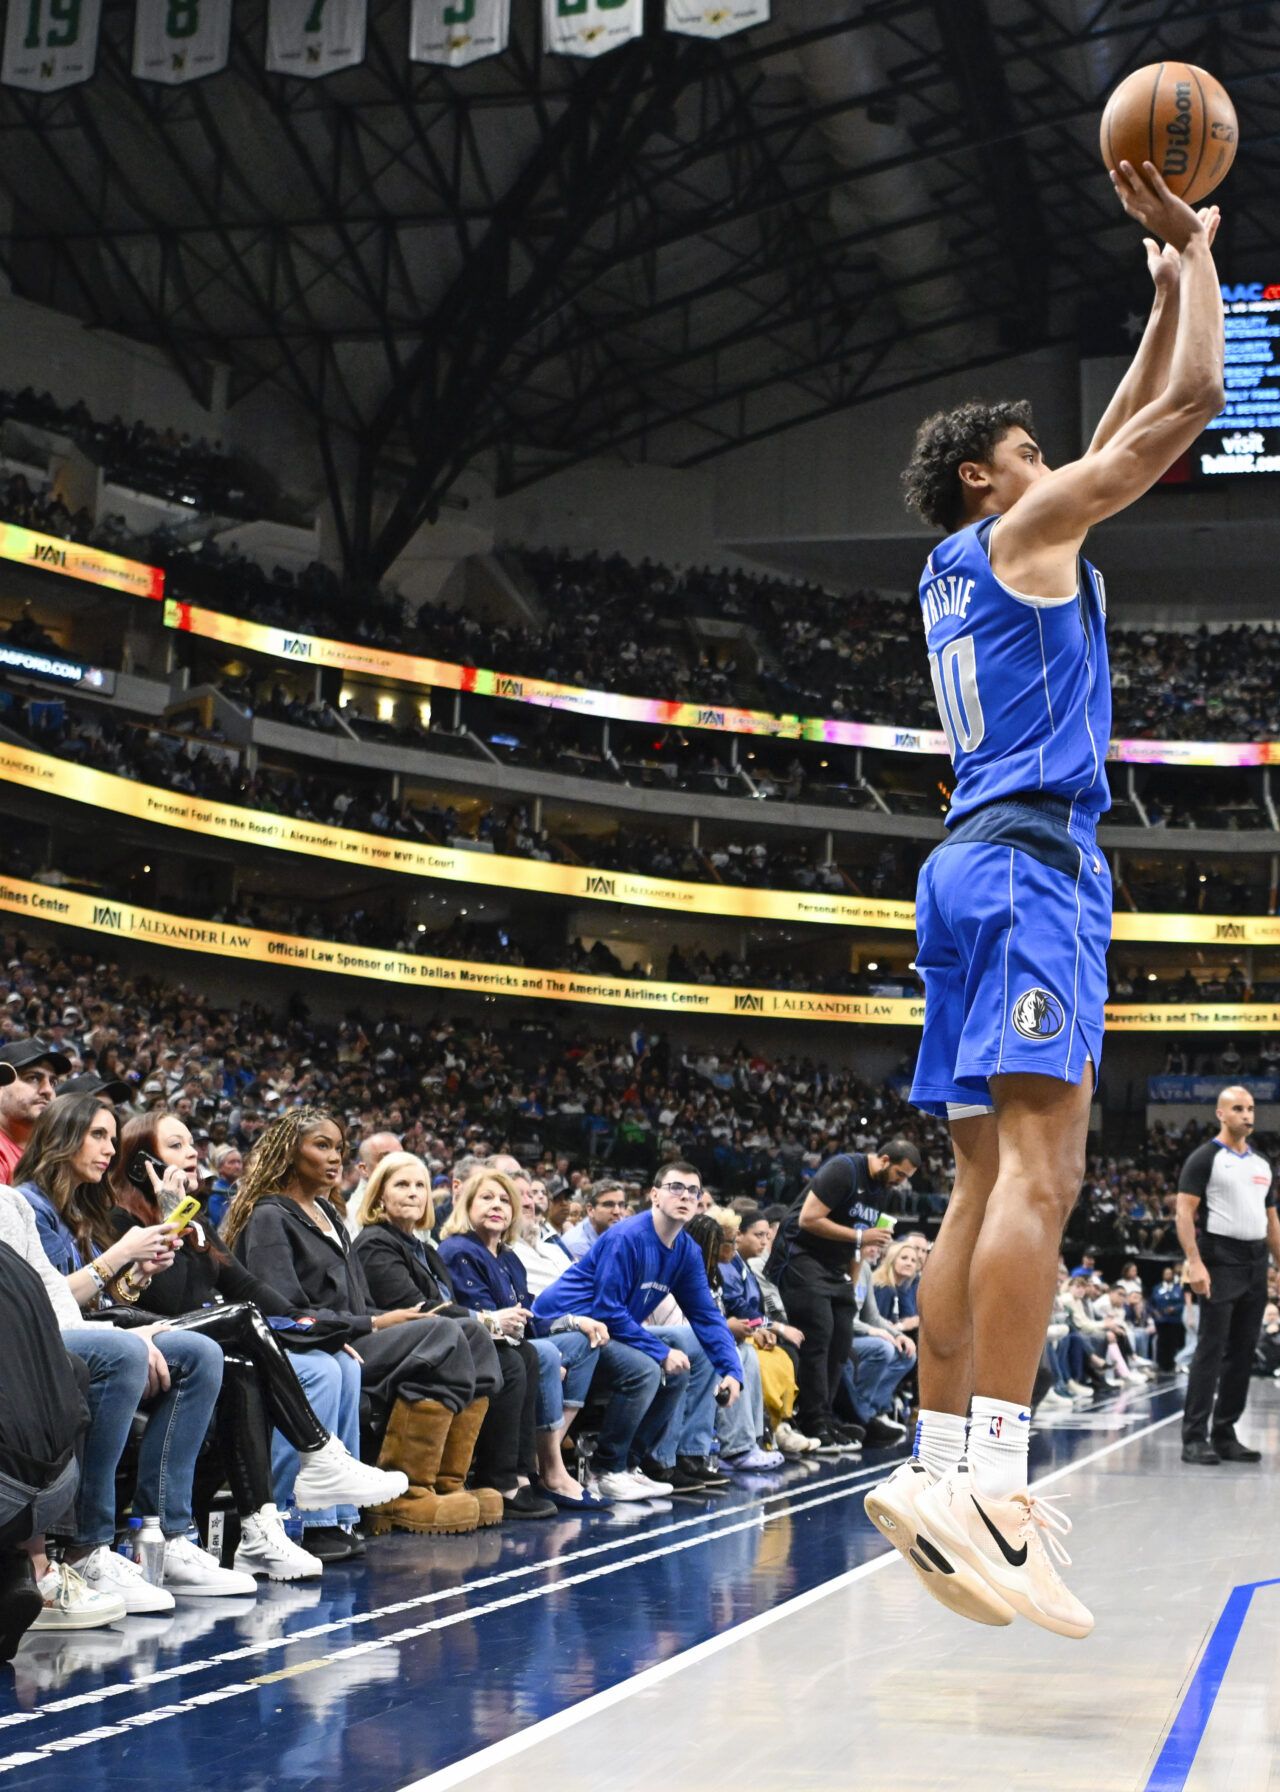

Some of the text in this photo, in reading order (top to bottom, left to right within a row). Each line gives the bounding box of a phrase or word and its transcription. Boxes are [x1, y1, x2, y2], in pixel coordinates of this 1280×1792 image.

[1163, 81, 1192, 176] Wilson
[1222, 432, 1265, 454] visit
[923, 576, 975, 637] RISTIE
[148, 798, 189, 817] Personal
[191, 809, 212, 823] Foul
[215, 816, 227, 824] on
[230, 819, 246, 829] the
[249, 822, 278, 836] Road?
[290, 831, 338, 848] Alexander
[340, 841, 358, 852] Law
[371, 848, 392, 859] your
[394, 851, 414, 862] MVP
[416, 855, 425, 864] in
[428, 857, 455, 869] Court
[32, 893, 70, 914] Center
[798, 903, 838, 914] Personal
[841, 907, 861, 916] Foul
[863, 908, 875, 916] on
[877, 909, 891, 918] the
[140, 919, 218, 944] ALEXANDER
[221, 931, 251, 948] LAW
[267, 941, 710, 1005] Official Law Sponsor of The Dallas Mavericks and The American Airlines Center
[783, 998, 861, 1015] ALEXANDER
[865, 1003, 894, 1016] LAW
[1105, 1011, 1162, 1024] Mavericks
[1166, 1012, 1186, 1024] and
[1190, 1012, 1210, 1023] The
[1213, 1012, 1268, 1023] American
